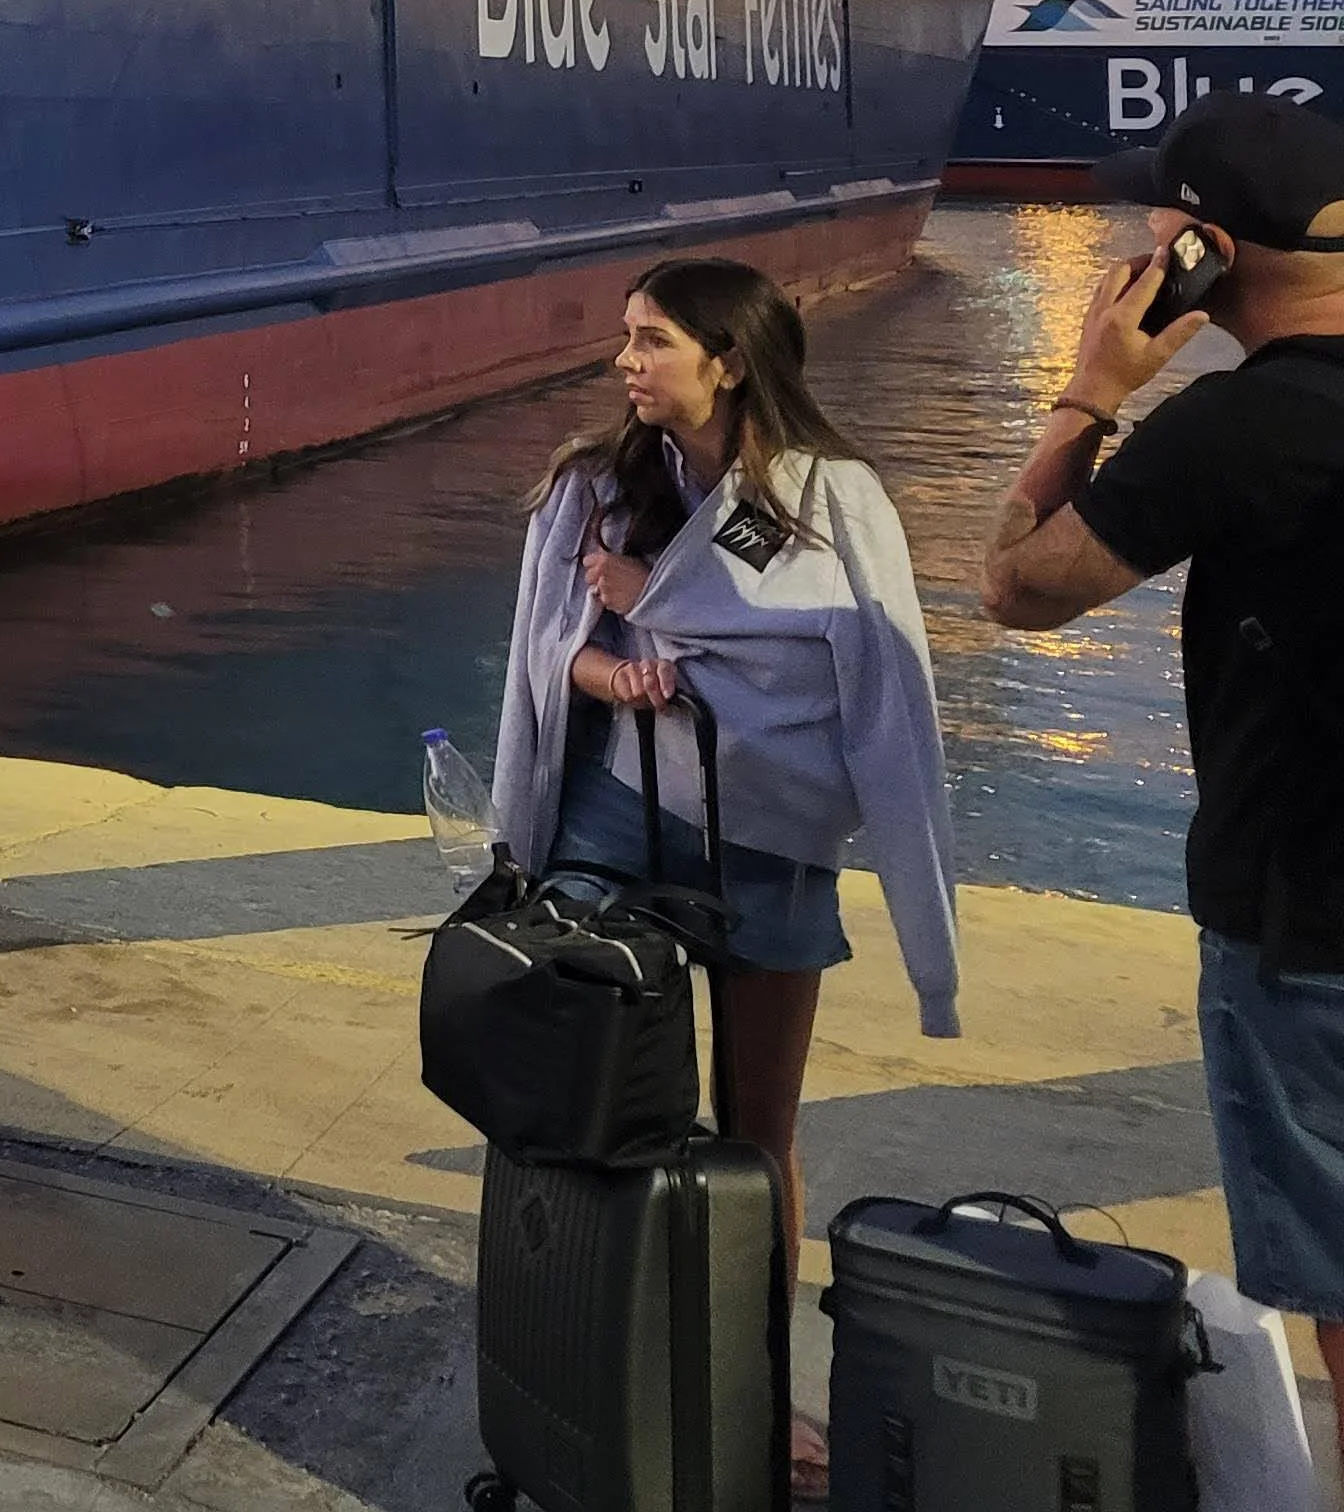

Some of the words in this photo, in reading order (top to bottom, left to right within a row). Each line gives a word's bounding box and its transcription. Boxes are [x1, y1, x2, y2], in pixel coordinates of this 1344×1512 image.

[1134, 15, 1293, 31] SUSTAINABLE
[1107, 56, 1324, 131] Bl
[938, 1360, 1033, 1415] YETI
